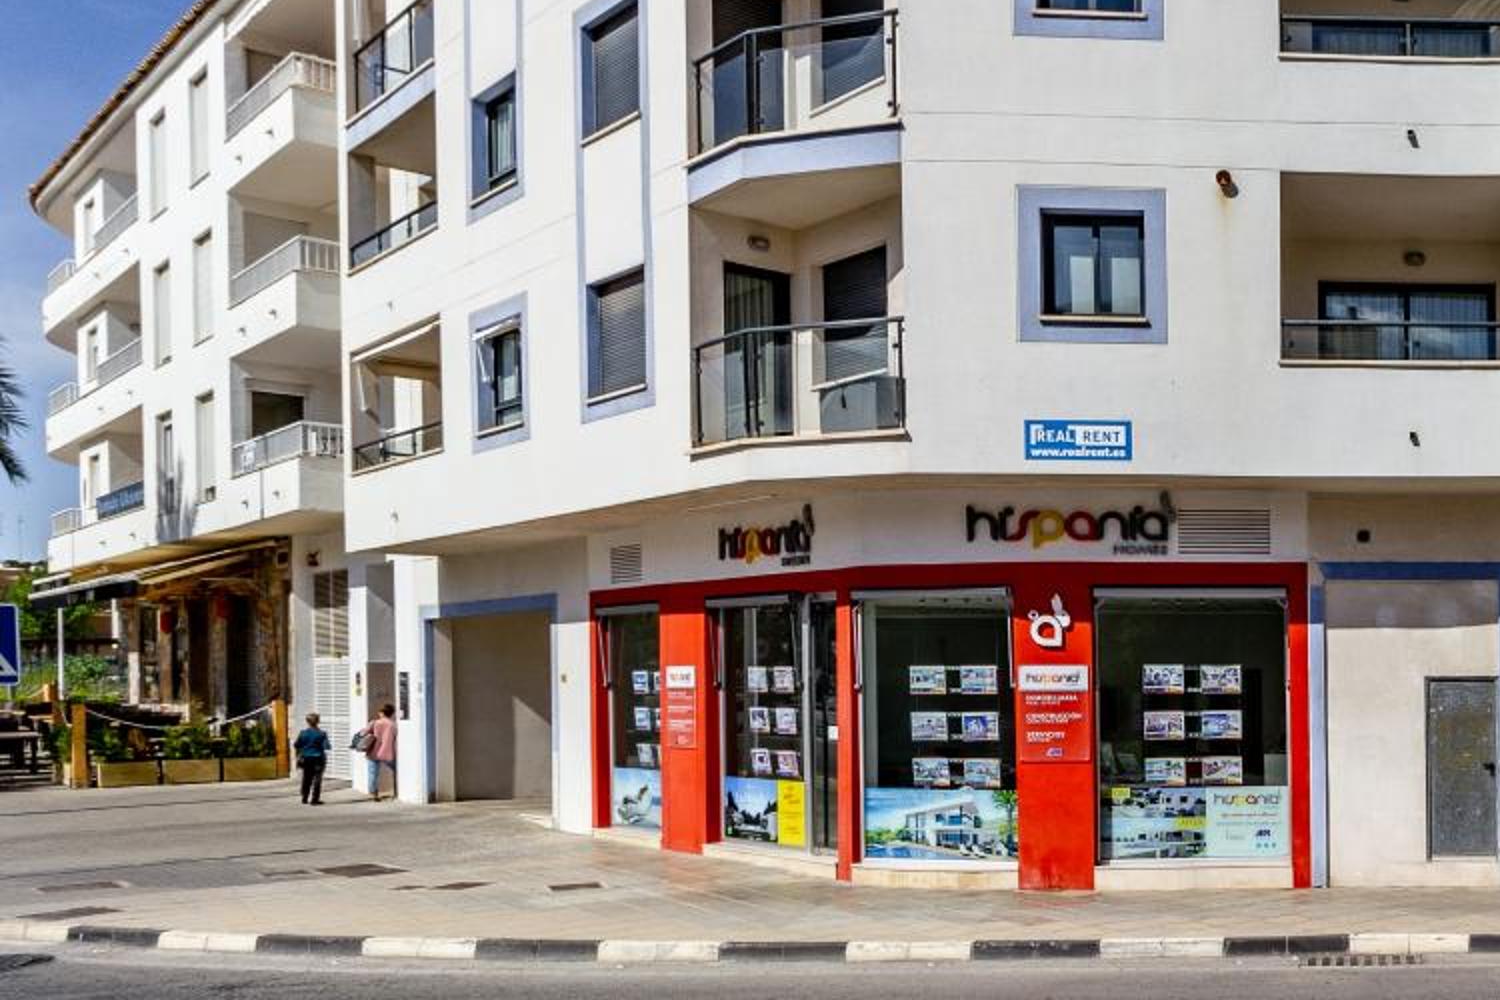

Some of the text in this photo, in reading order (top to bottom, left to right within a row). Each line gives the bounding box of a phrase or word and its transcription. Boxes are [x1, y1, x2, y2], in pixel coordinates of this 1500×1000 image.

[1036, 429, 1121, 443] REAL RENT
[1030, 446, 1127, 457] www.realrent.es
[966, 500, 1173, 548] hispania
